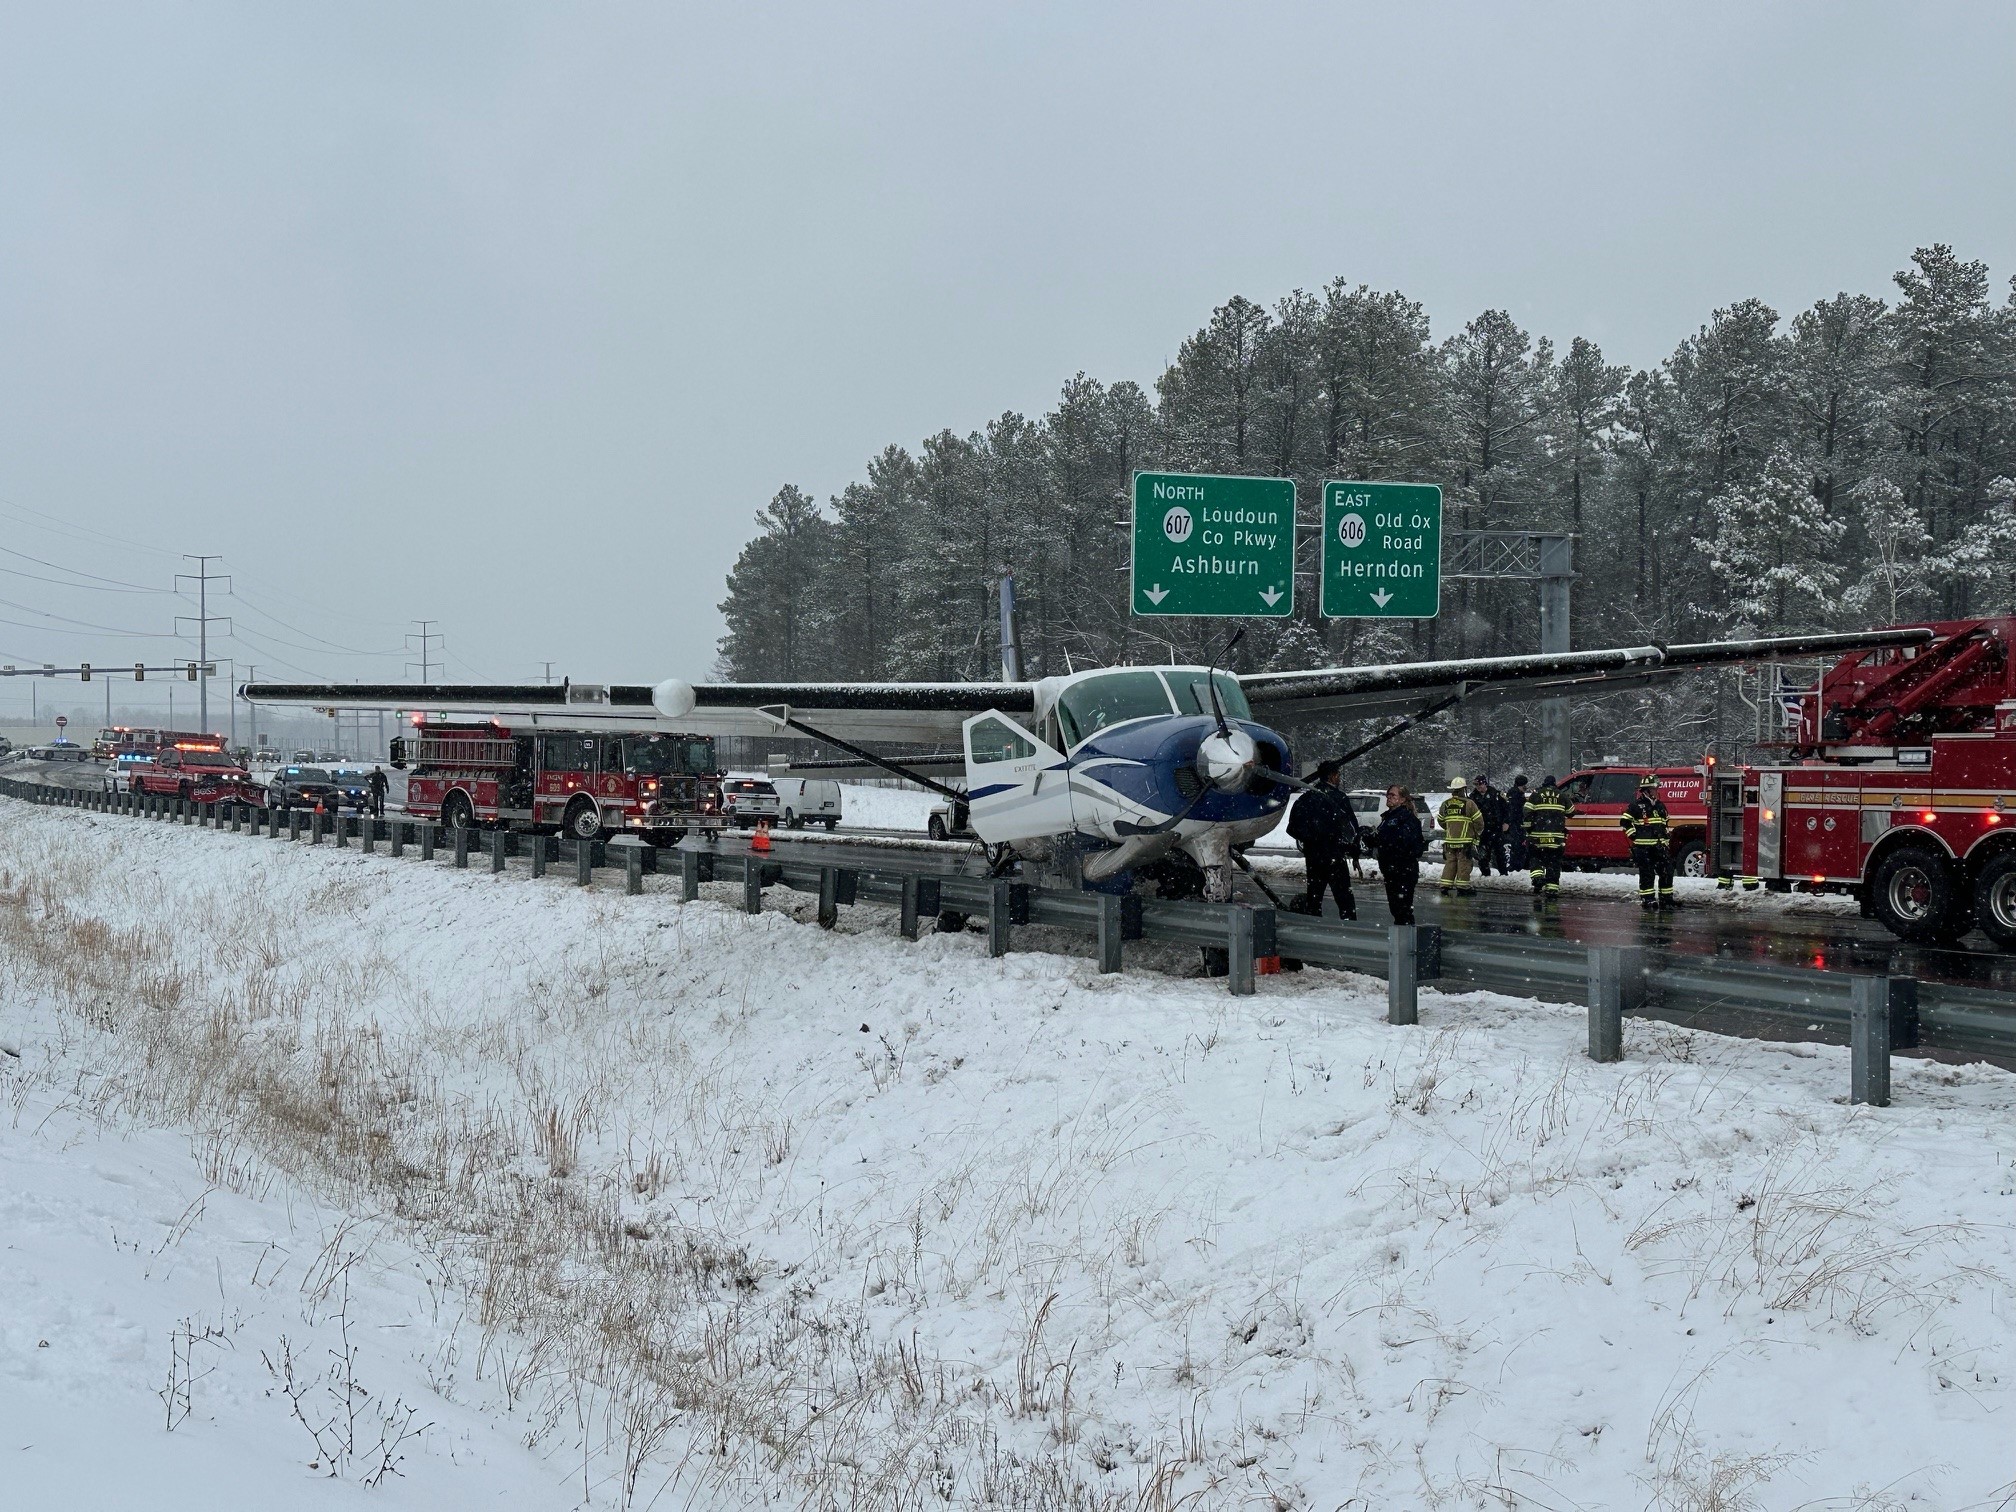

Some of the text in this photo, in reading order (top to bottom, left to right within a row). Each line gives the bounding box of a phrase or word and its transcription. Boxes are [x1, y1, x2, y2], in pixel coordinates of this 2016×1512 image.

[1153, 482, 1204, 500] NORTH
[1335, 490, 1371, 507] EAST
[1202, 507, 1278, 524] Loudoun
[1375, 512, 1431, 529] Old Ox
[1165, 515, 1191, 535] 607
[1341, 521, 1364, 540] 606
[1202, 530, 1277, 551] Co Pkwy
[1383, 535, 1422, 550] Road
[1170, 554, 1259, 575] Ashburn
[1341, 560, 1423, 578] Herndon
[193, 788, 217, 796] BOSS
[1667, 790, 1688, 799] CHIEF
[1824, 793, 1860, 804] RESCUE
